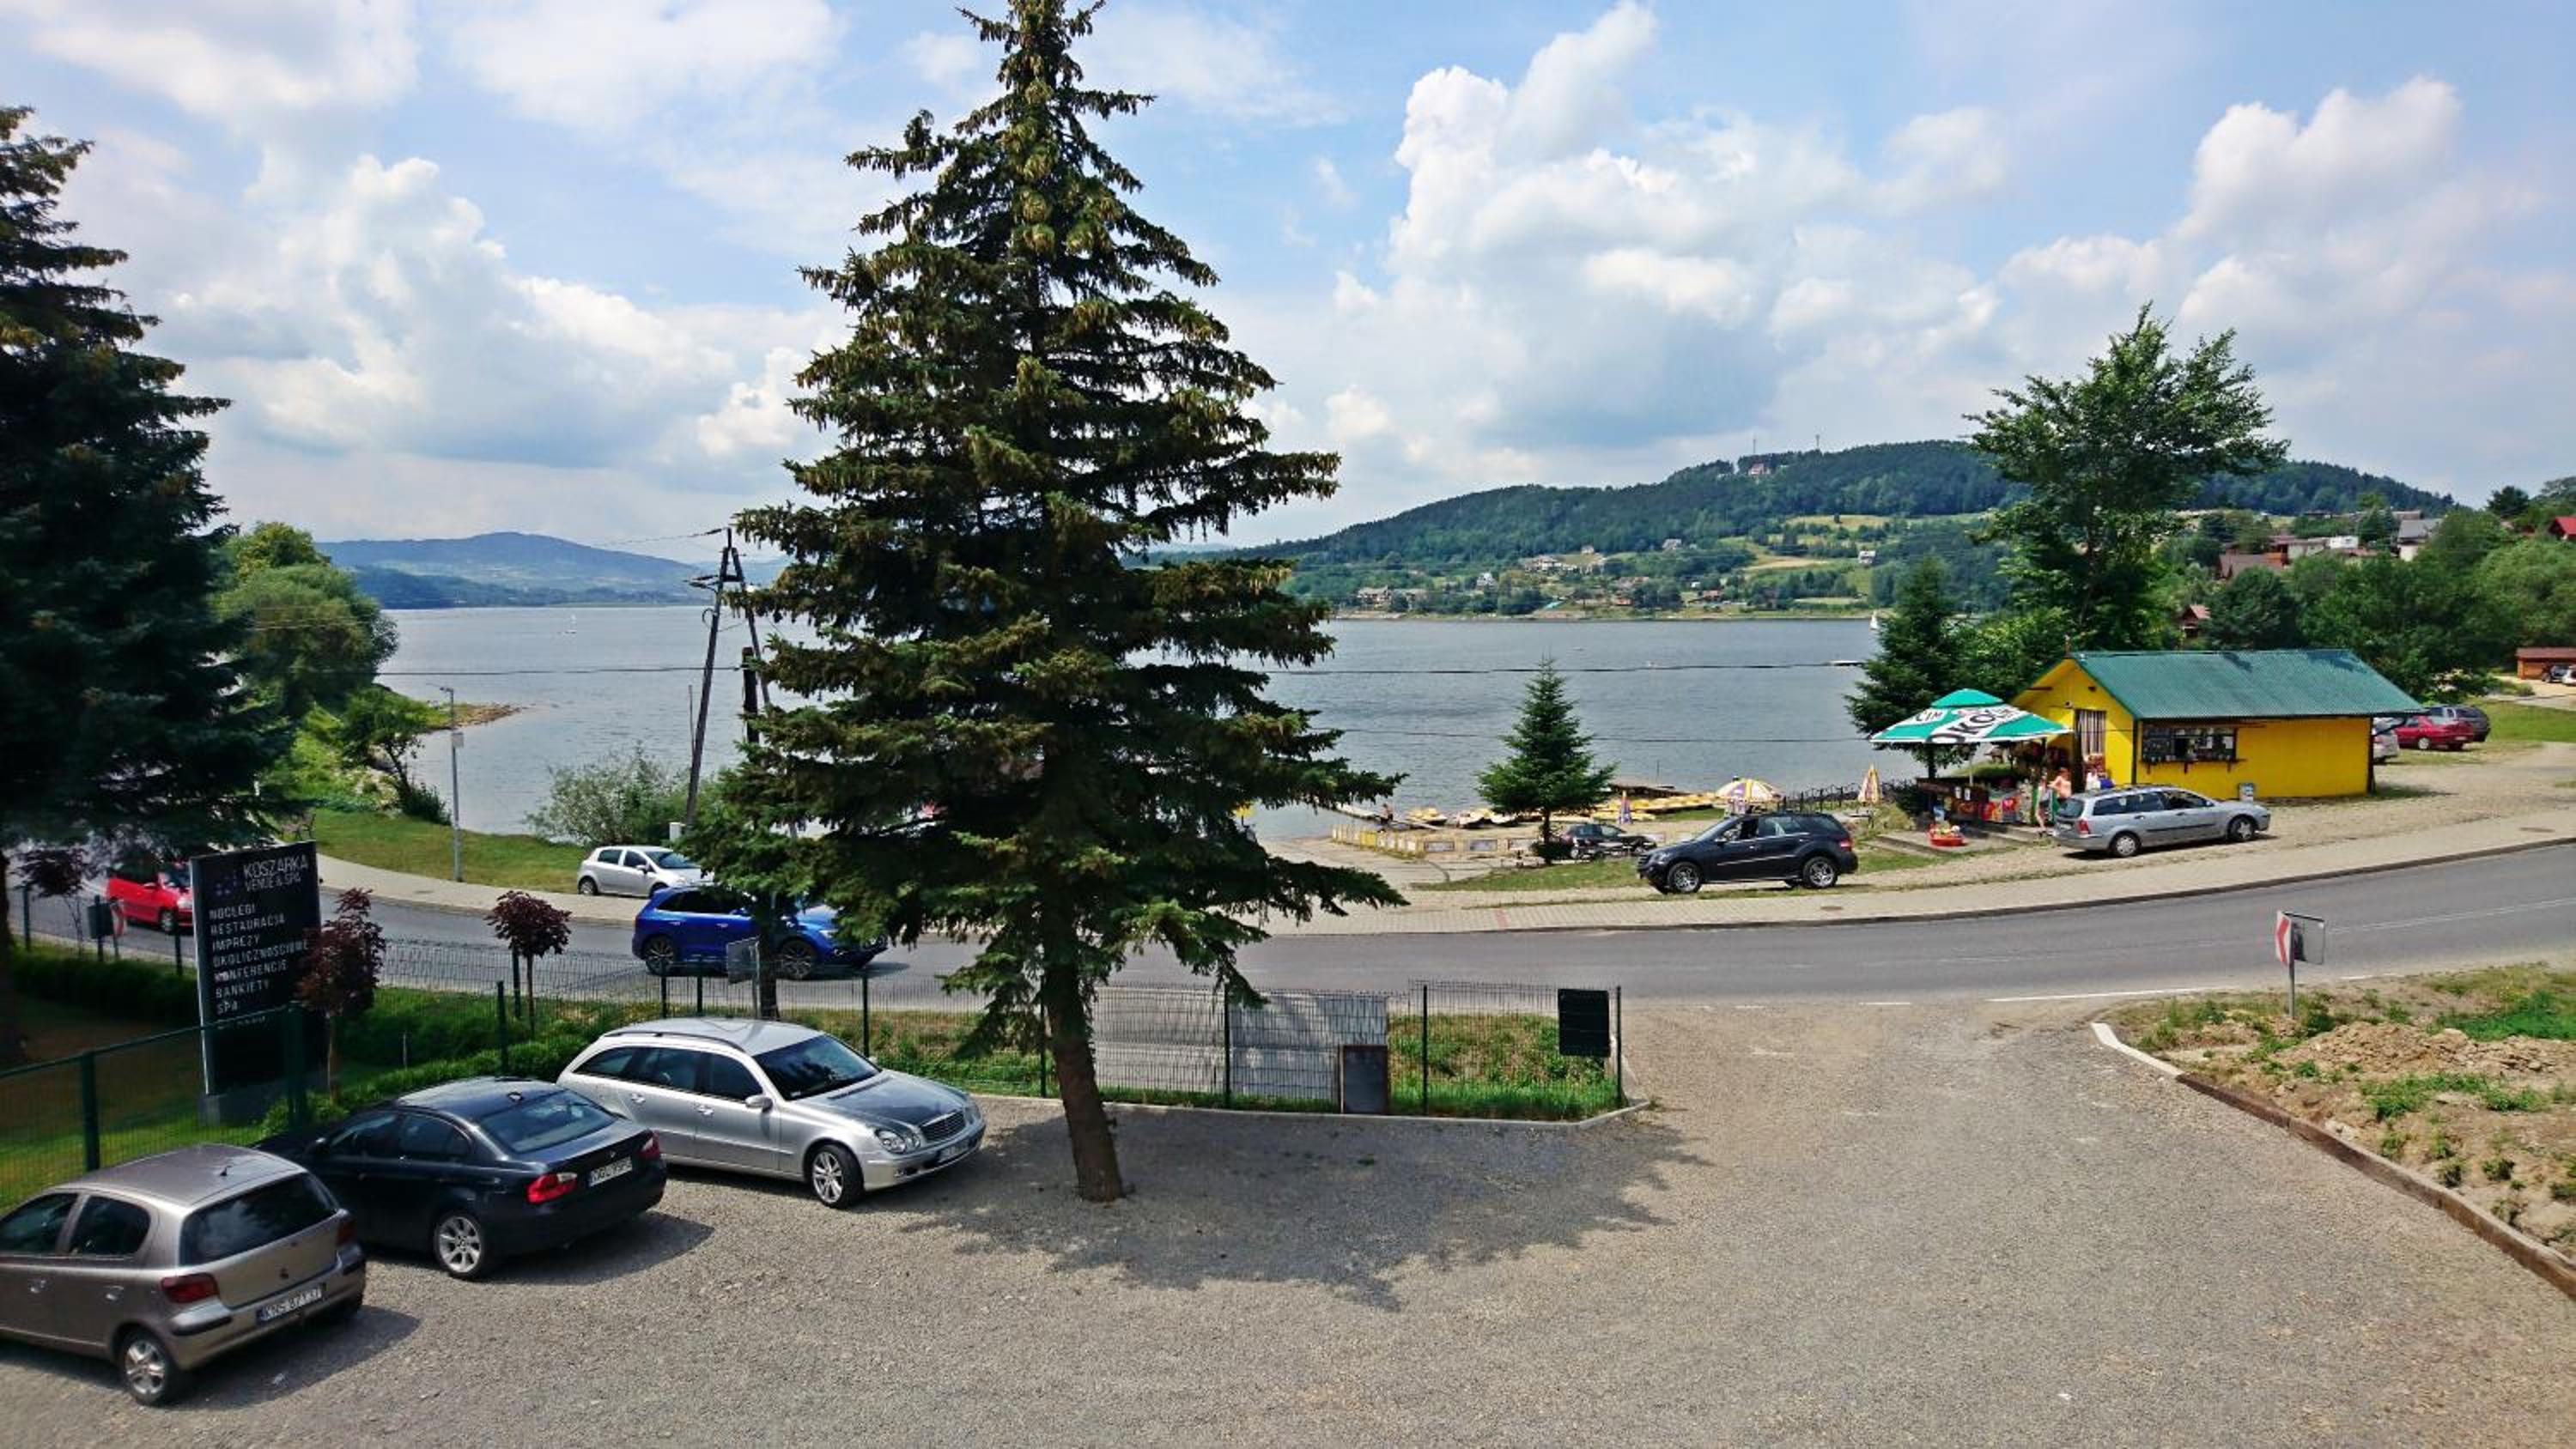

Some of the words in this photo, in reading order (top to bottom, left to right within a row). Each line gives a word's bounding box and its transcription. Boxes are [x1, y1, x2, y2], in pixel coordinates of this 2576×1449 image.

[243, 855, 308, 879] KOSZARKA
[209, 903, 256, 919] NOCLEGI
[210, 913, 285, 936] RESTAURACJA
[212, 934, 260, 951] IMPREZY
[216, 979, 270, 998] BANKIETY
[217, 1000, 239, 1015] SPA
